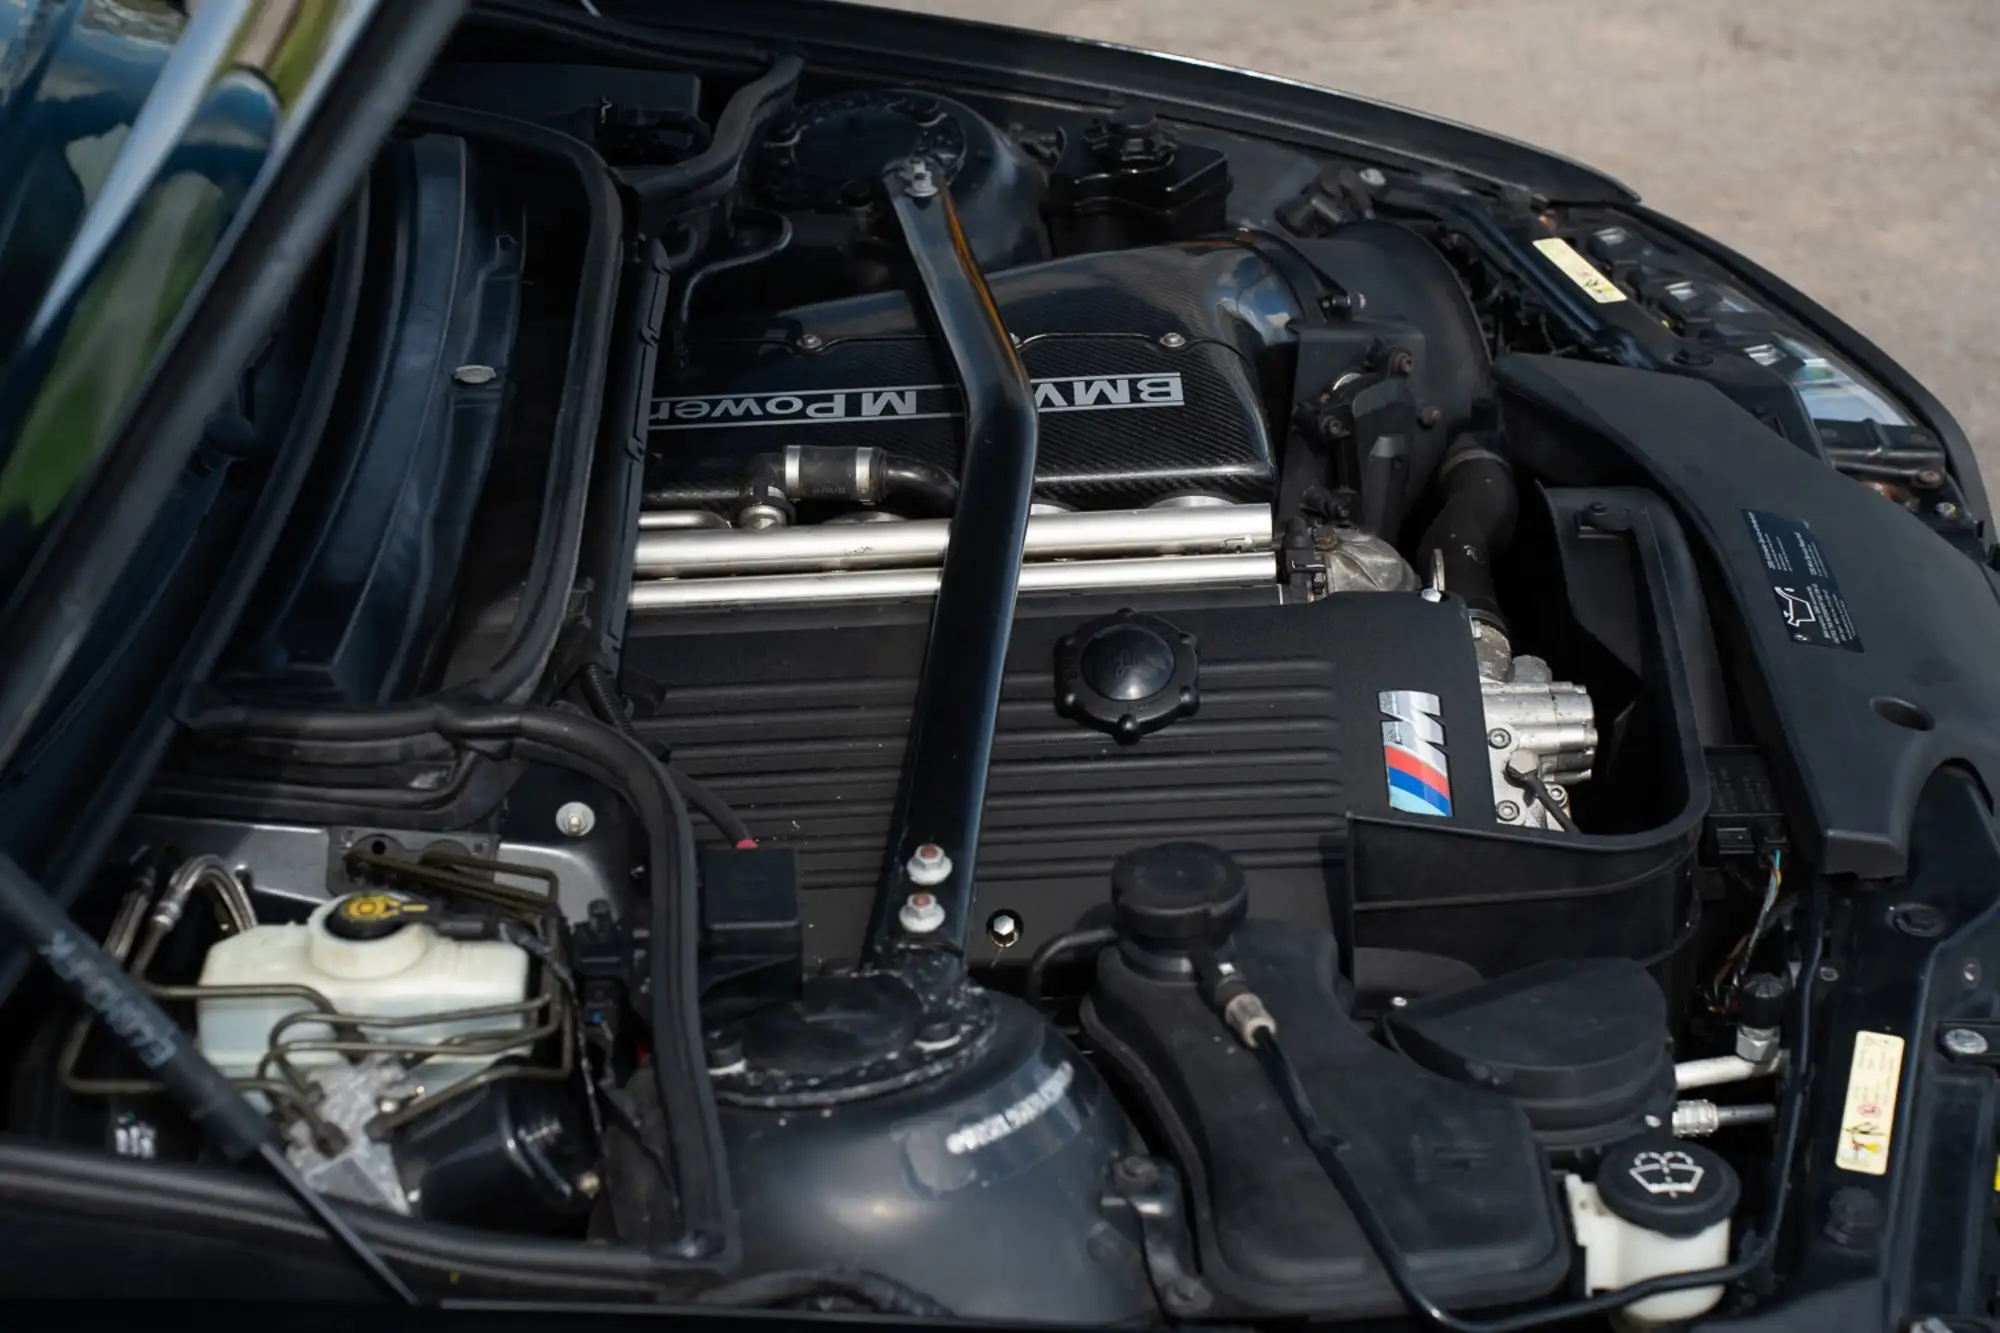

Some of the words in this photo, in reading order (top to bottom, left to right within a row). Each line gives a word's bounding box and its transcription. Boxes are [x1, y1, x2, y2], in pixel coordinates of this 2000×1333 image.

[649, 393, 846, 420] Power
[861, 390, 917, 417] M
[1379, 690, 1449, 780] M
